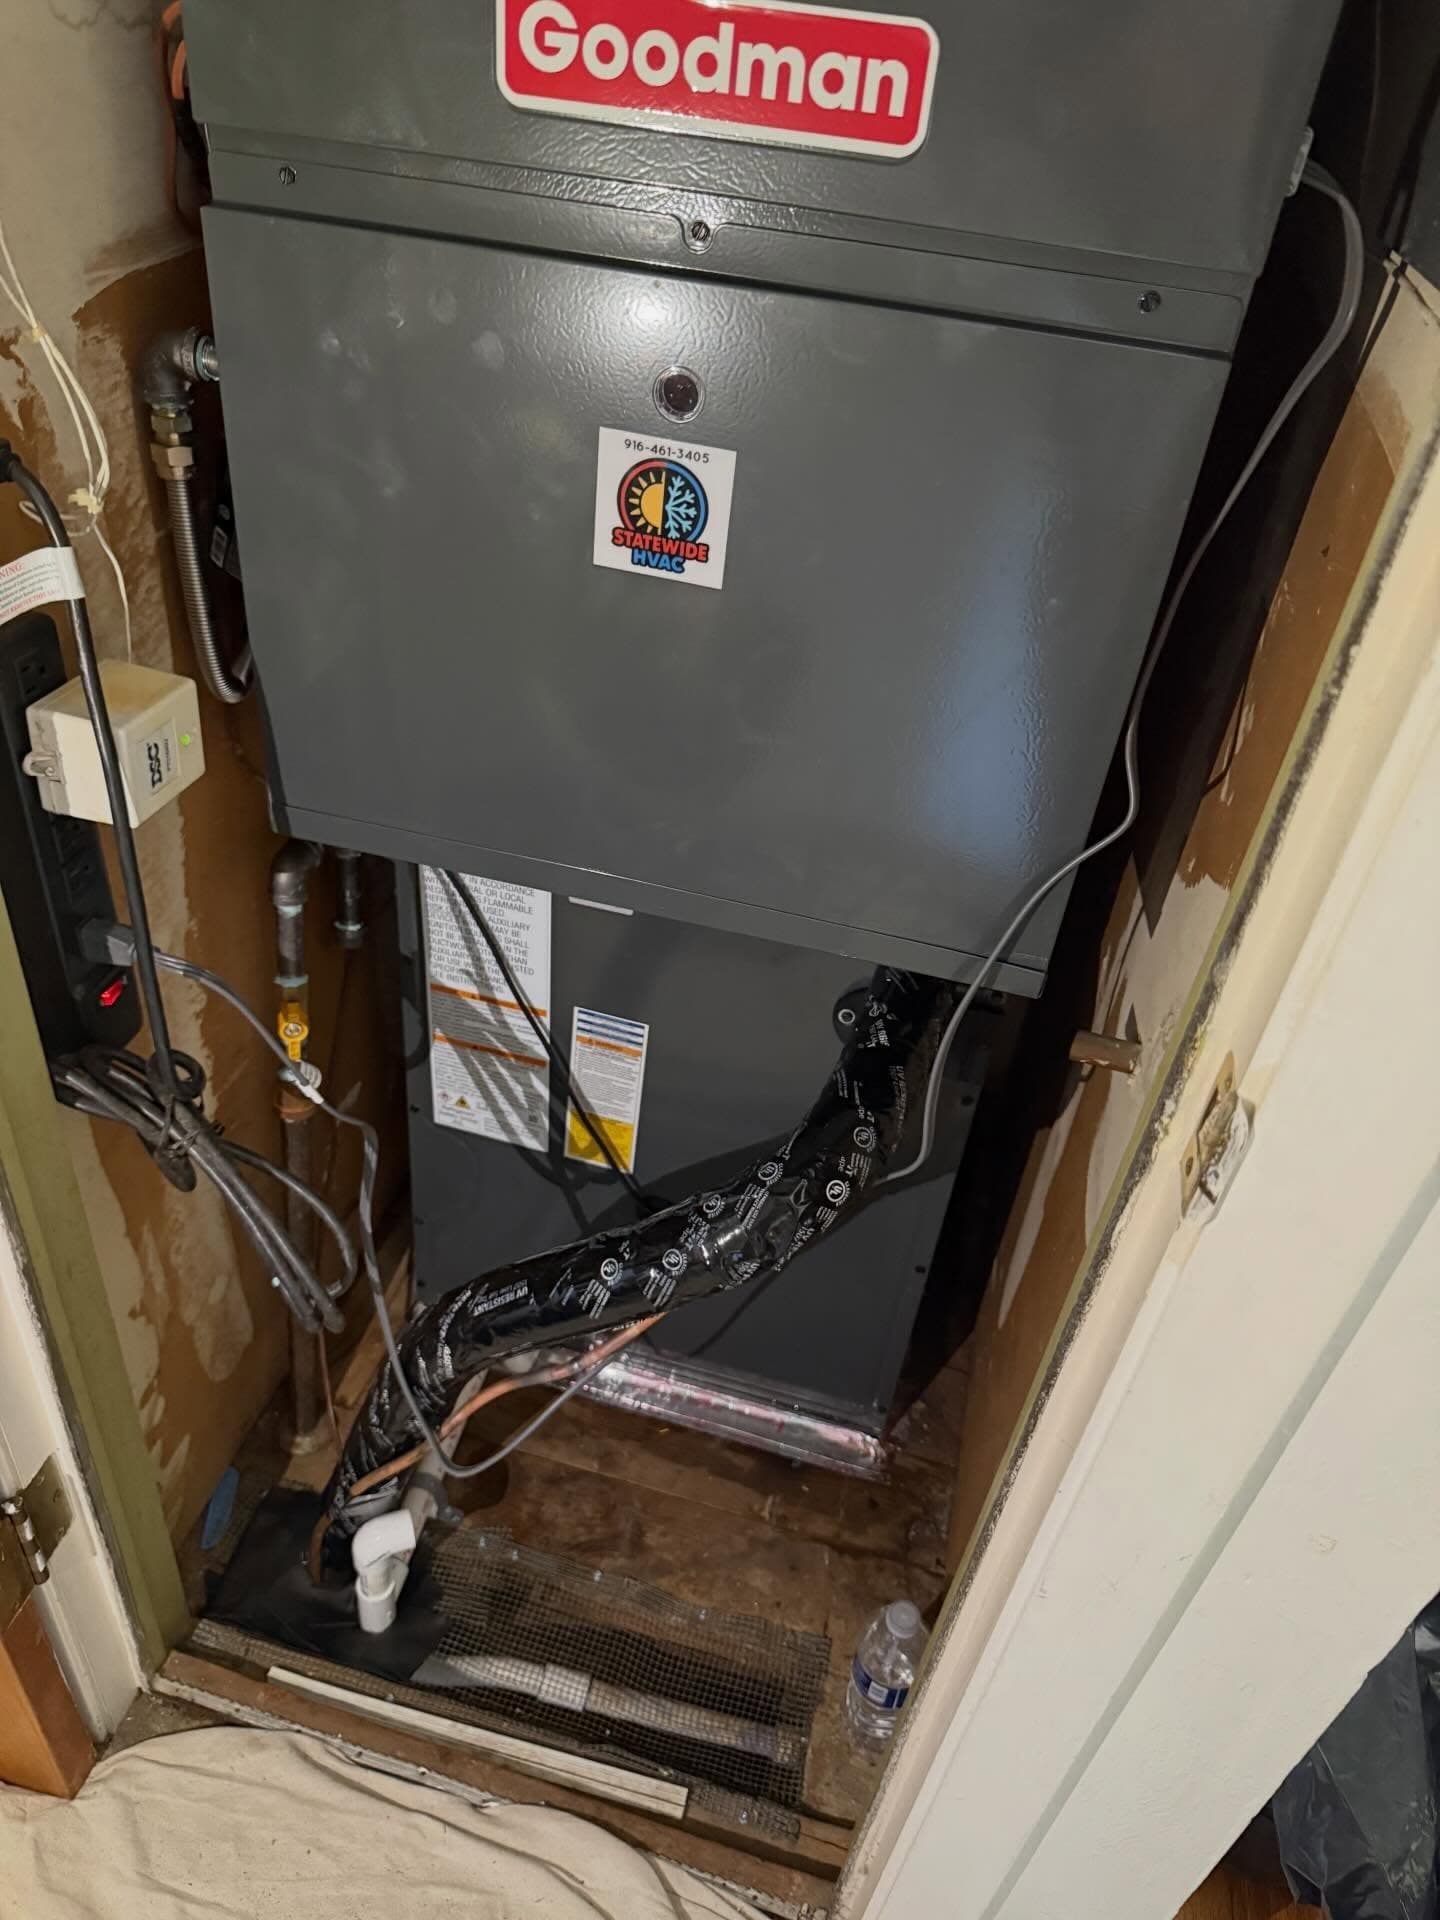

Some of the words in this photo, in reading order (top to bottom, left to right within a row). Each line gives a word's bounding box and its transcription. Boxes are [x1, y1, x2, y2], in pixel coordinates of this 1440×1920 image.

[518, 0, 909, 117] Goodman
[624, 438, 710, 464] 916-461-3405
[612, 528, 709, 562] STATEWIDE
[631, 549, 685, 573] HVAC
[480, 879, 535, 897] ACCORDANCE
[485, 888, 498, 899] OR
[499, 891, 526, 905] LOCAL
[483, 896, 534, 915] FLAMMABLE
[483, 904, 505, 917] USED
[488, 915, 531, 932] AUXILIARY
